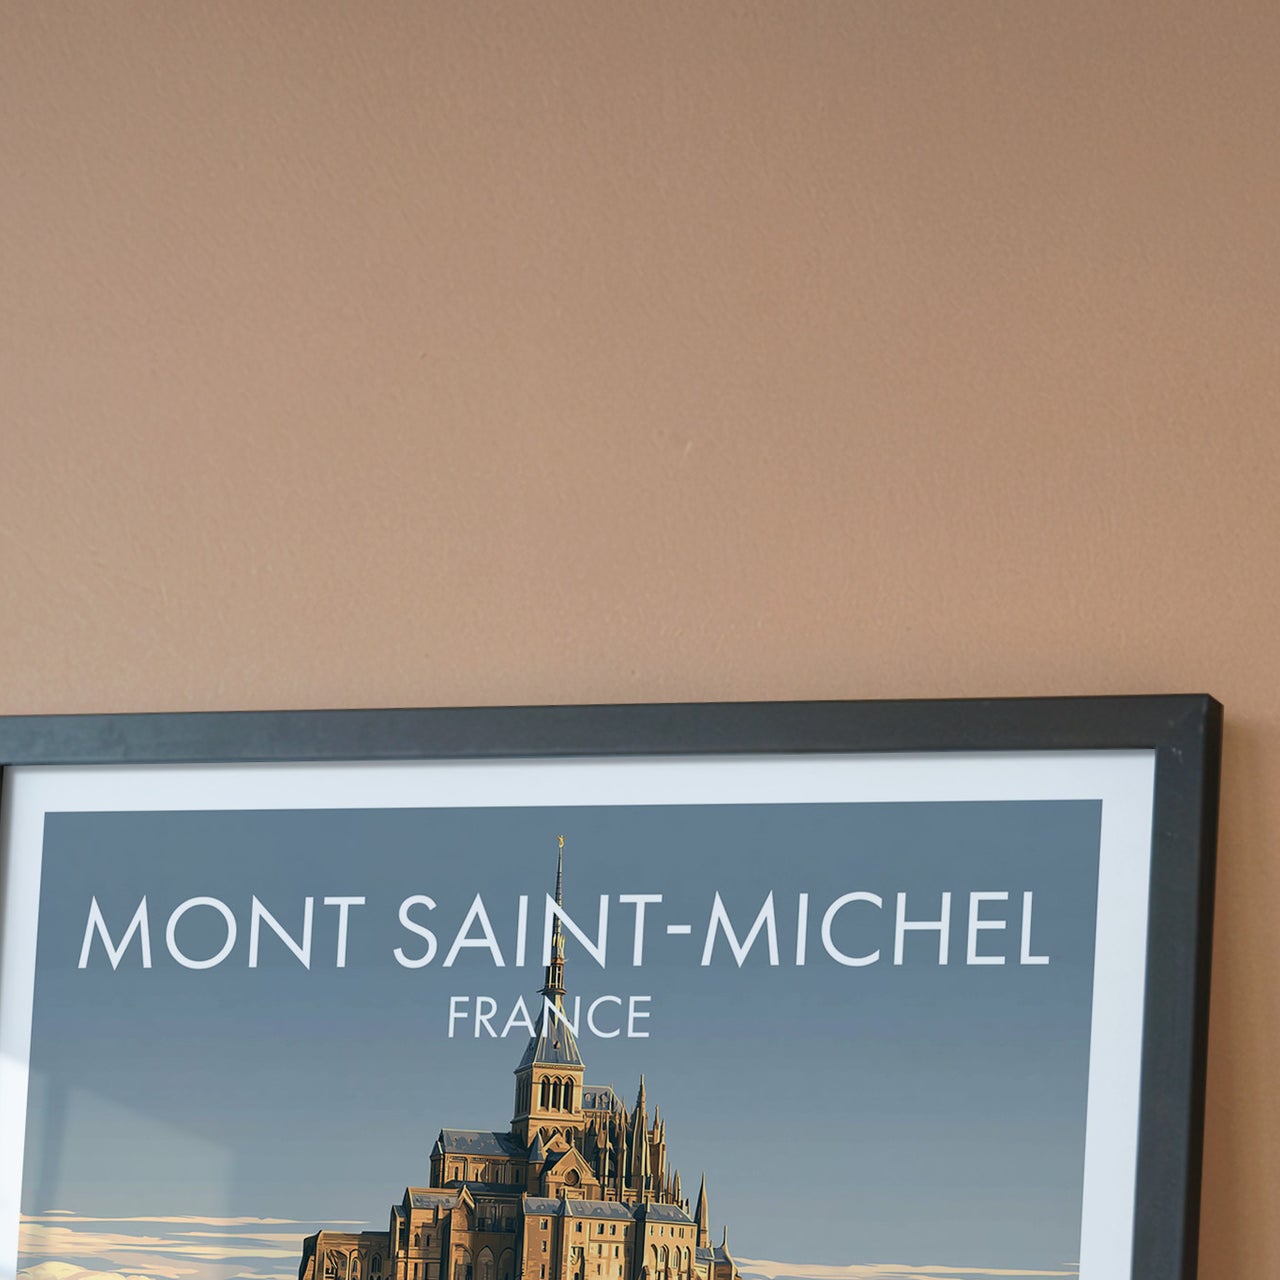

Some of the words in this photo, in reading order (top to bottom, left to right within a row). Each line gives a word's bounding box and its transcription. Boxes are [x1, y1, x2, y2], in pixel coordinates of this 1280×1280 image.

[77, 894, 366, 971] MONT
[392, 891, 1051, 969] SAINT-MICHEL
[446, 995, 652, 1038] FRANCE
